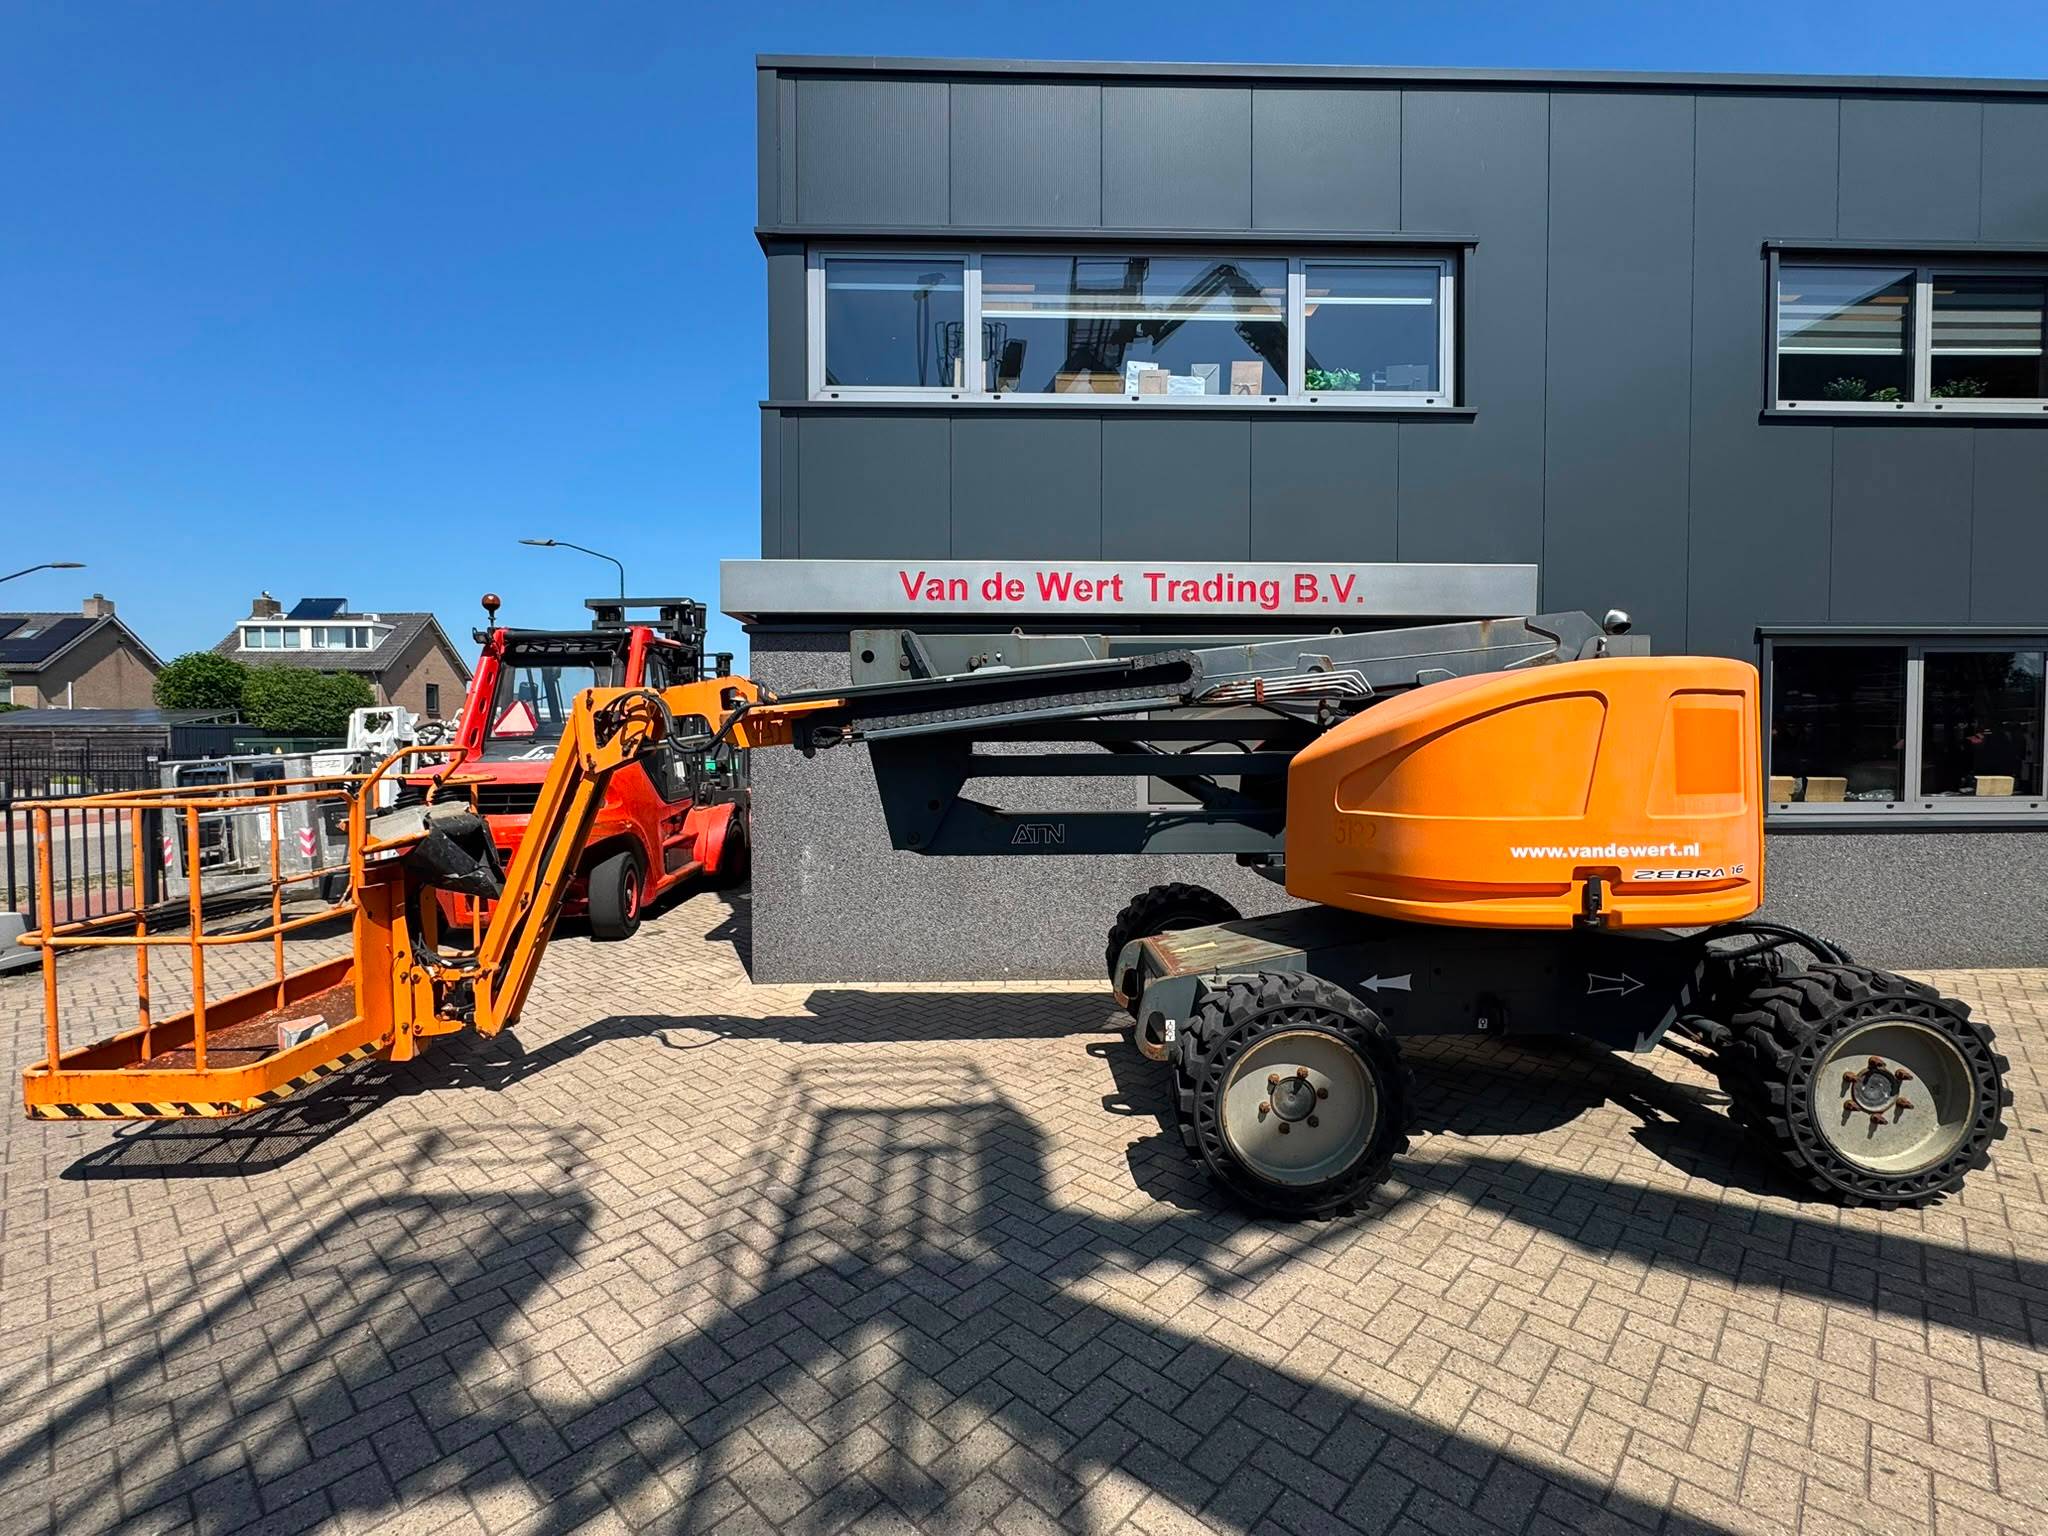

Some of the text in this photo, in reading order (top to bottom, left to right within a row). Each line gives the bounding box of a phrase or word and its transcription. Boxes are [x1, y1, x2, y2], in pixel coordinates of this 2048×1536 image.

[899, 571, 1364, 610] Van de Wert Trading B.V.
[507, 744, 560, 761] Lin
[1010, 823, 1065, 845] ATN
[1510, 842, 1700, 858] www.vandewert.nl
[1633, 864, 1744, 880] ZEBRA 16
